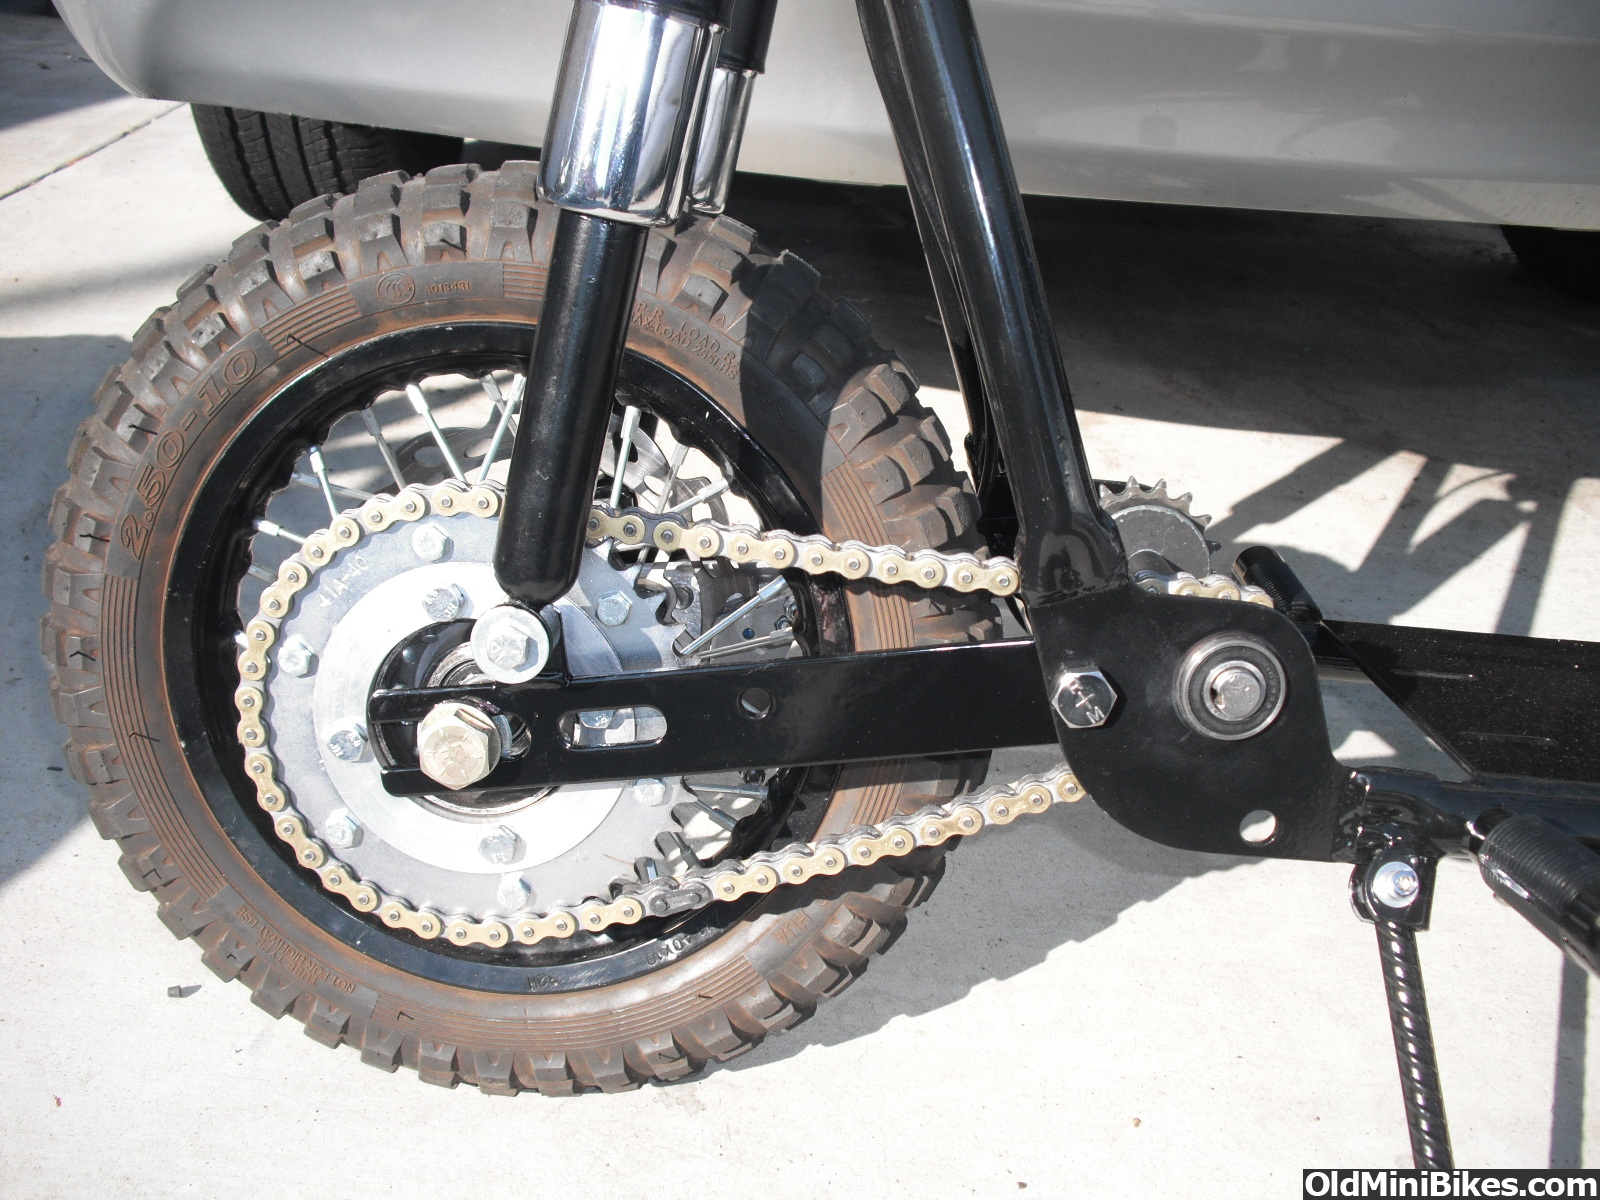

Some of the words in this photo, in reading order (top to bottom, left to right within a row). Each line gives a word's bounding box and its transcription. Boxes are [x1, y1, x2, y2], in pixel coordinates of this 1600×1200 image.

[680, 322, 720, 353] LOAD
[121, 350, 257, 560] 2.50-10
[236, 905, 259, 929] USE
[260, 926, 307, 968] HIGHWAY
[305, 961, 331, 981] FOR
[332, 975, 356, 994] NOT
